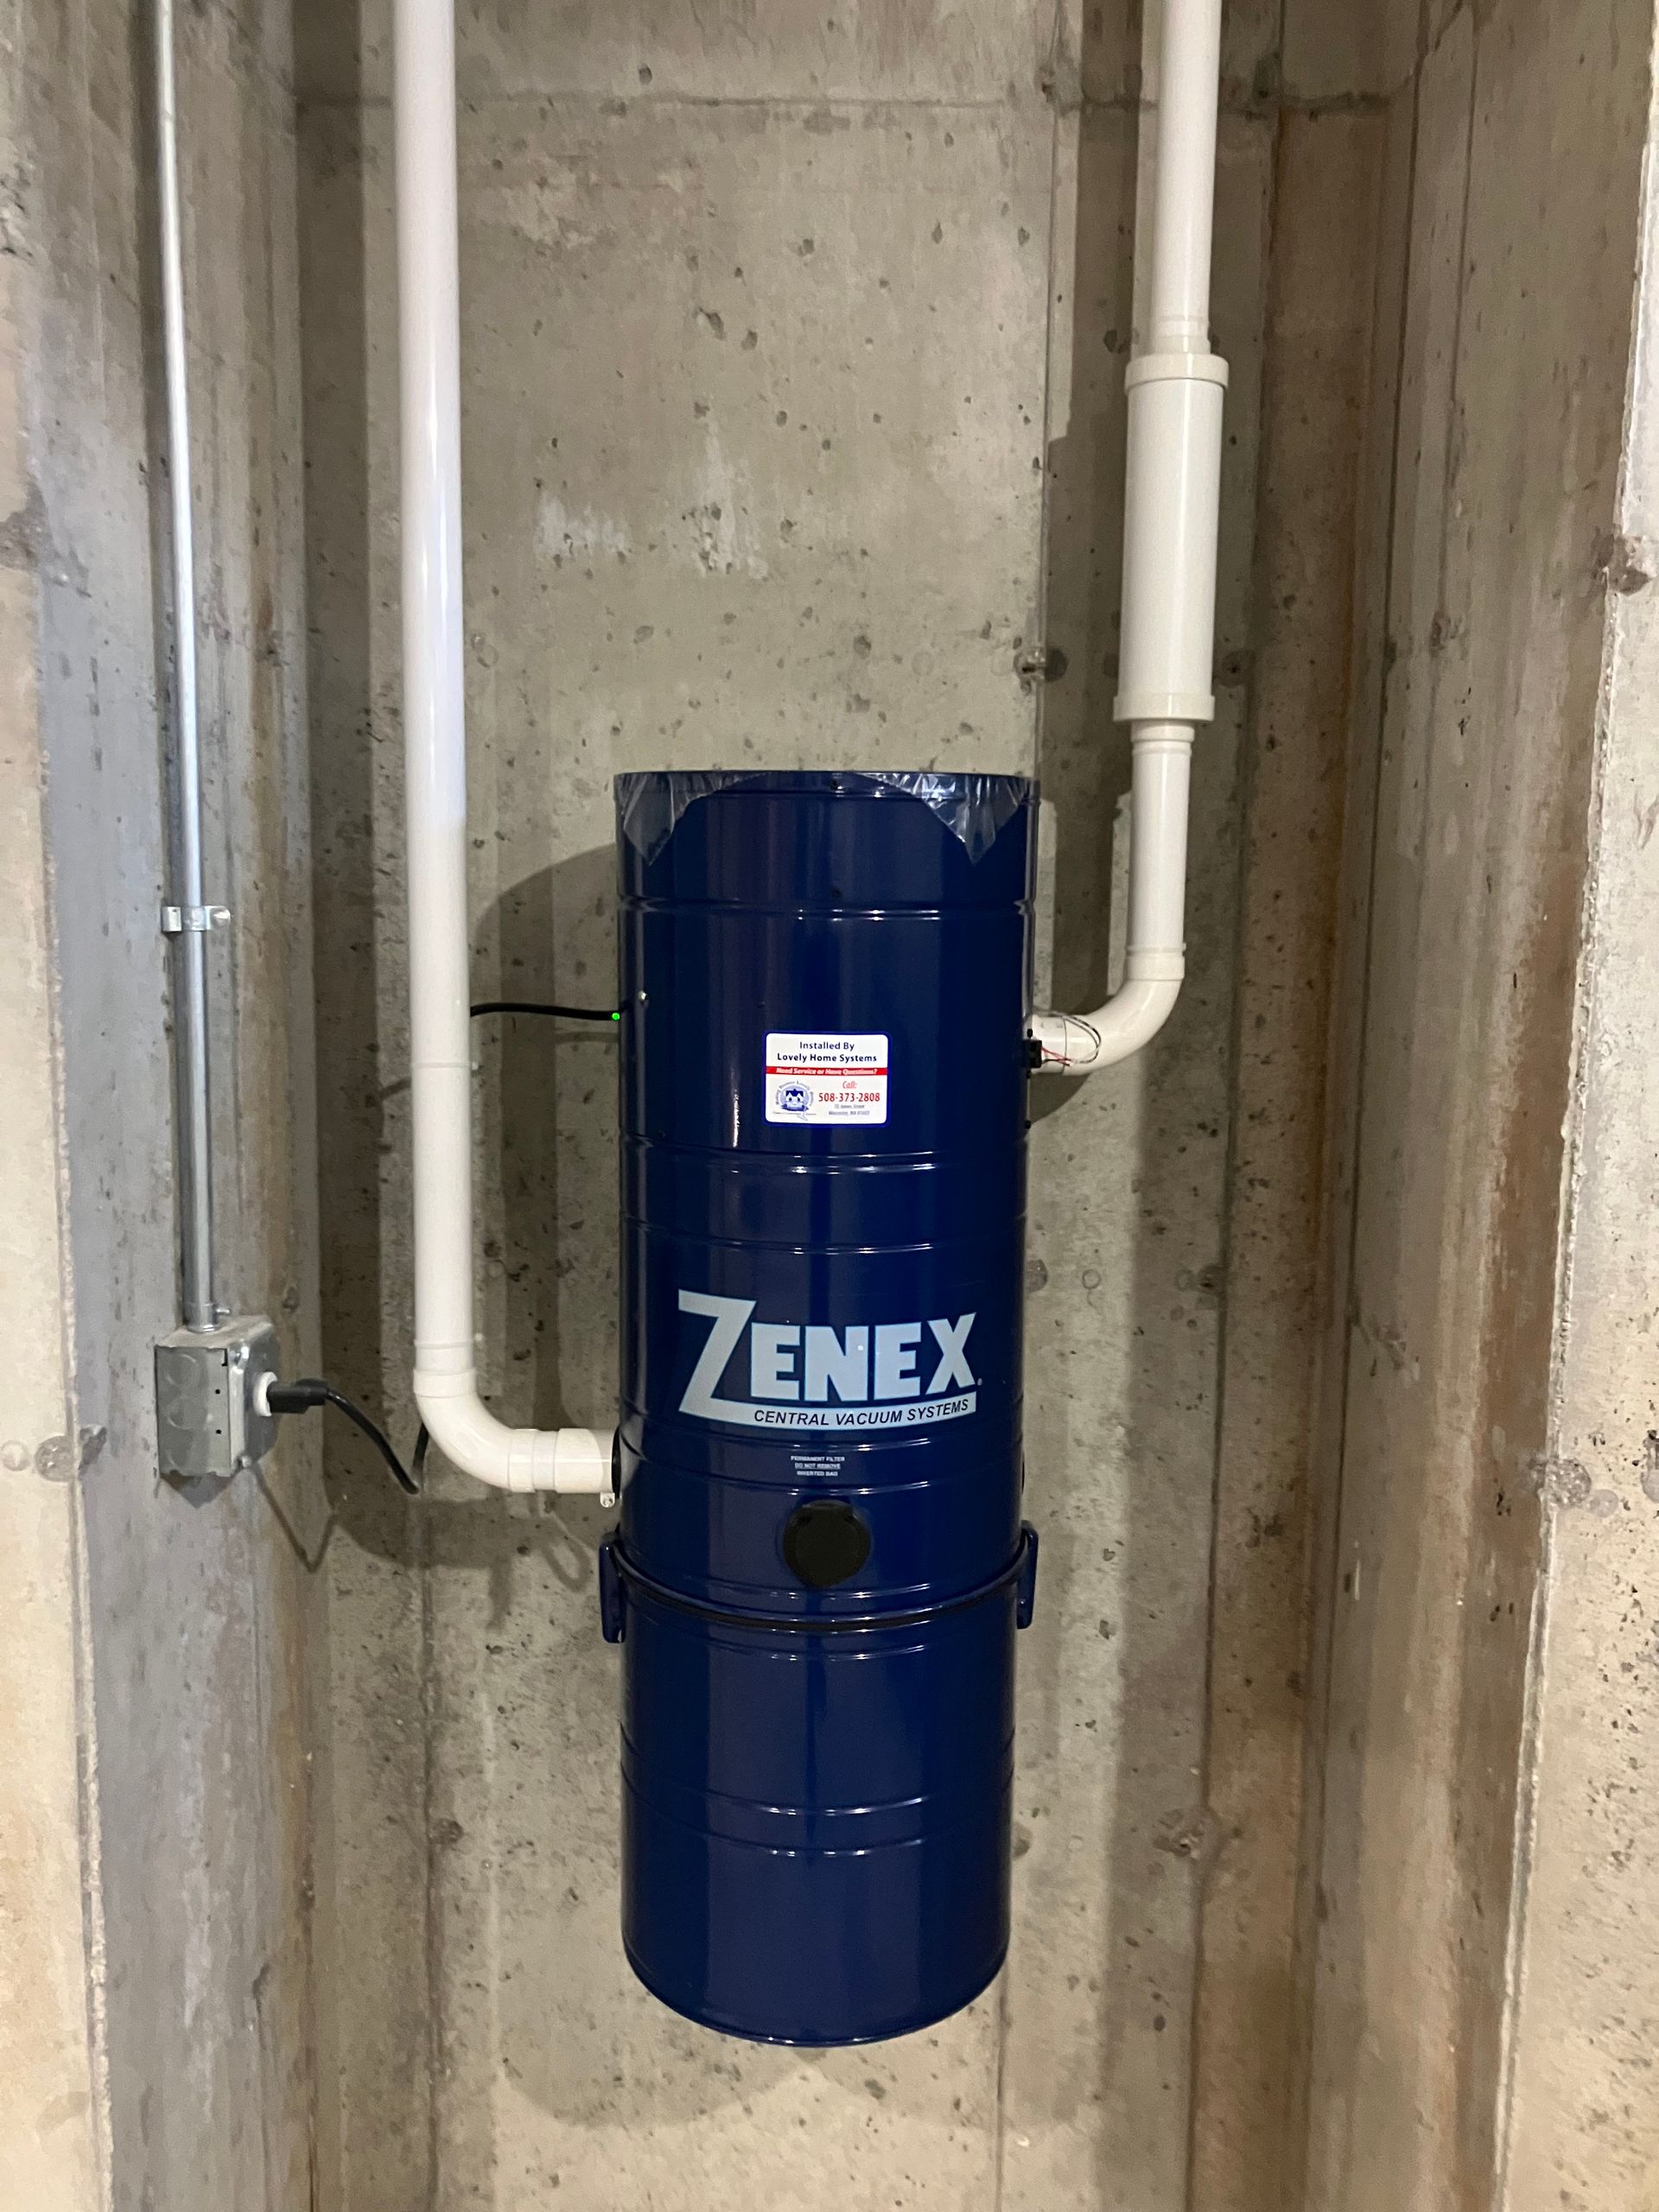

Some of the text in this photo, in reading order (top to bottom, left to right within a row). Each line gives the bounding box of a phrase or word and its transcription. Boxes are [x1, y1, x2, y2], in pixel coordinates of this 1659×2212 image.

[799, 1041, 855, 1052] Installed By
[777, 1053, 877, 1064] Lovely Home Systems
[818, 1092, 880, 1103] 508-373-2808
[678, 1289, 977, 1417] ZENEX
[753, 1398, 969, 1427] CENTRAL VACUUM SYSTEMS
